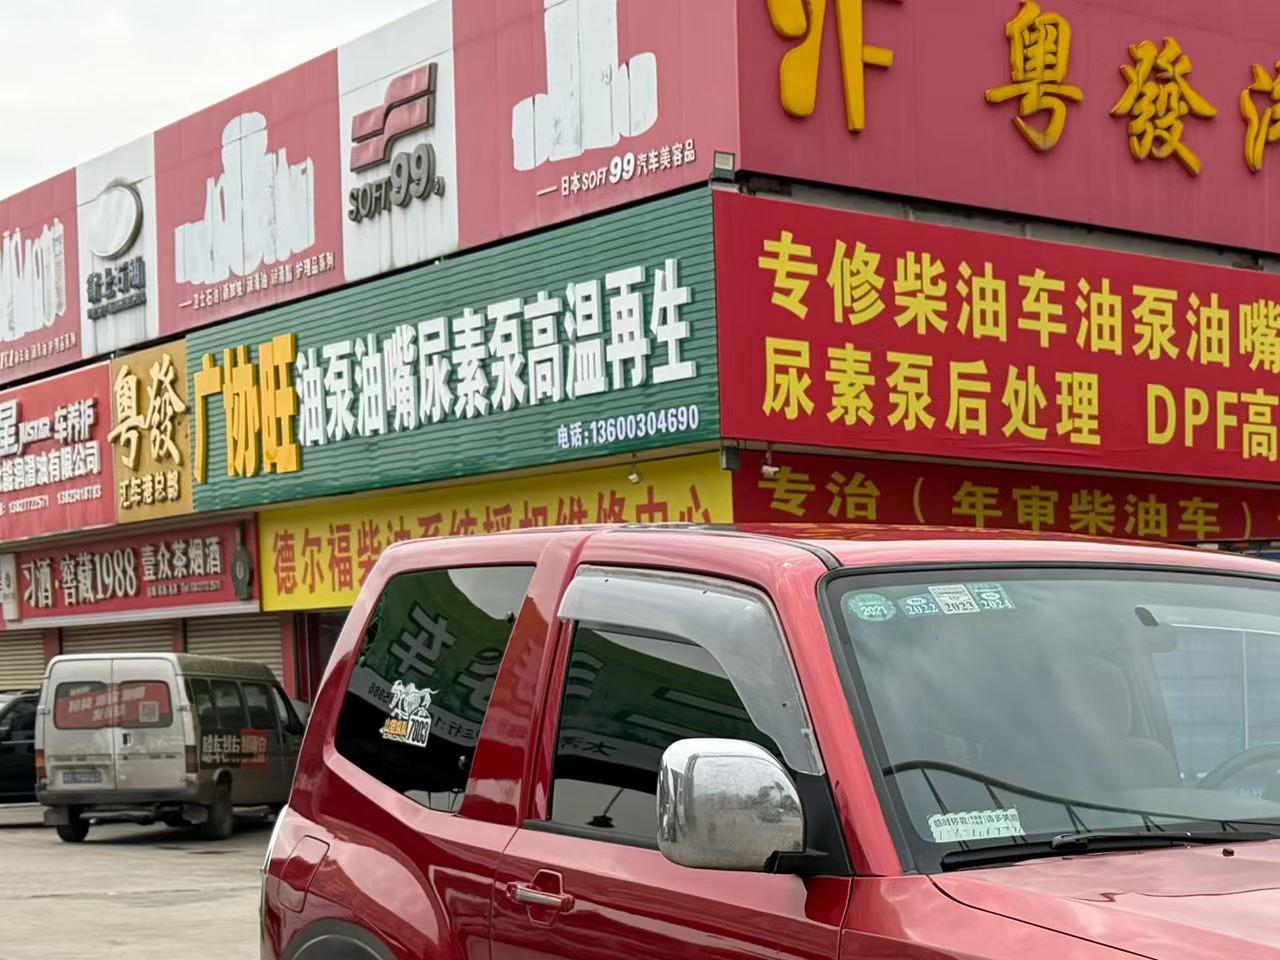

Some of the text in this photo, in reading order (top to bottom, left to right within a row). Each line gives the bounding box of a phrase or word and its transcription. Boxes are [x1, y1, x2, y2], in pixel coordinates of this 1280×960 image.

[762, 337, 1102, 447] 尿素泵后处理
[905, 603, 939, 615] 2022
[945, 602, 977, 612] 2023
[981, 599, 1012, 610] 2024
[860, 605, 887, 616] 2021
